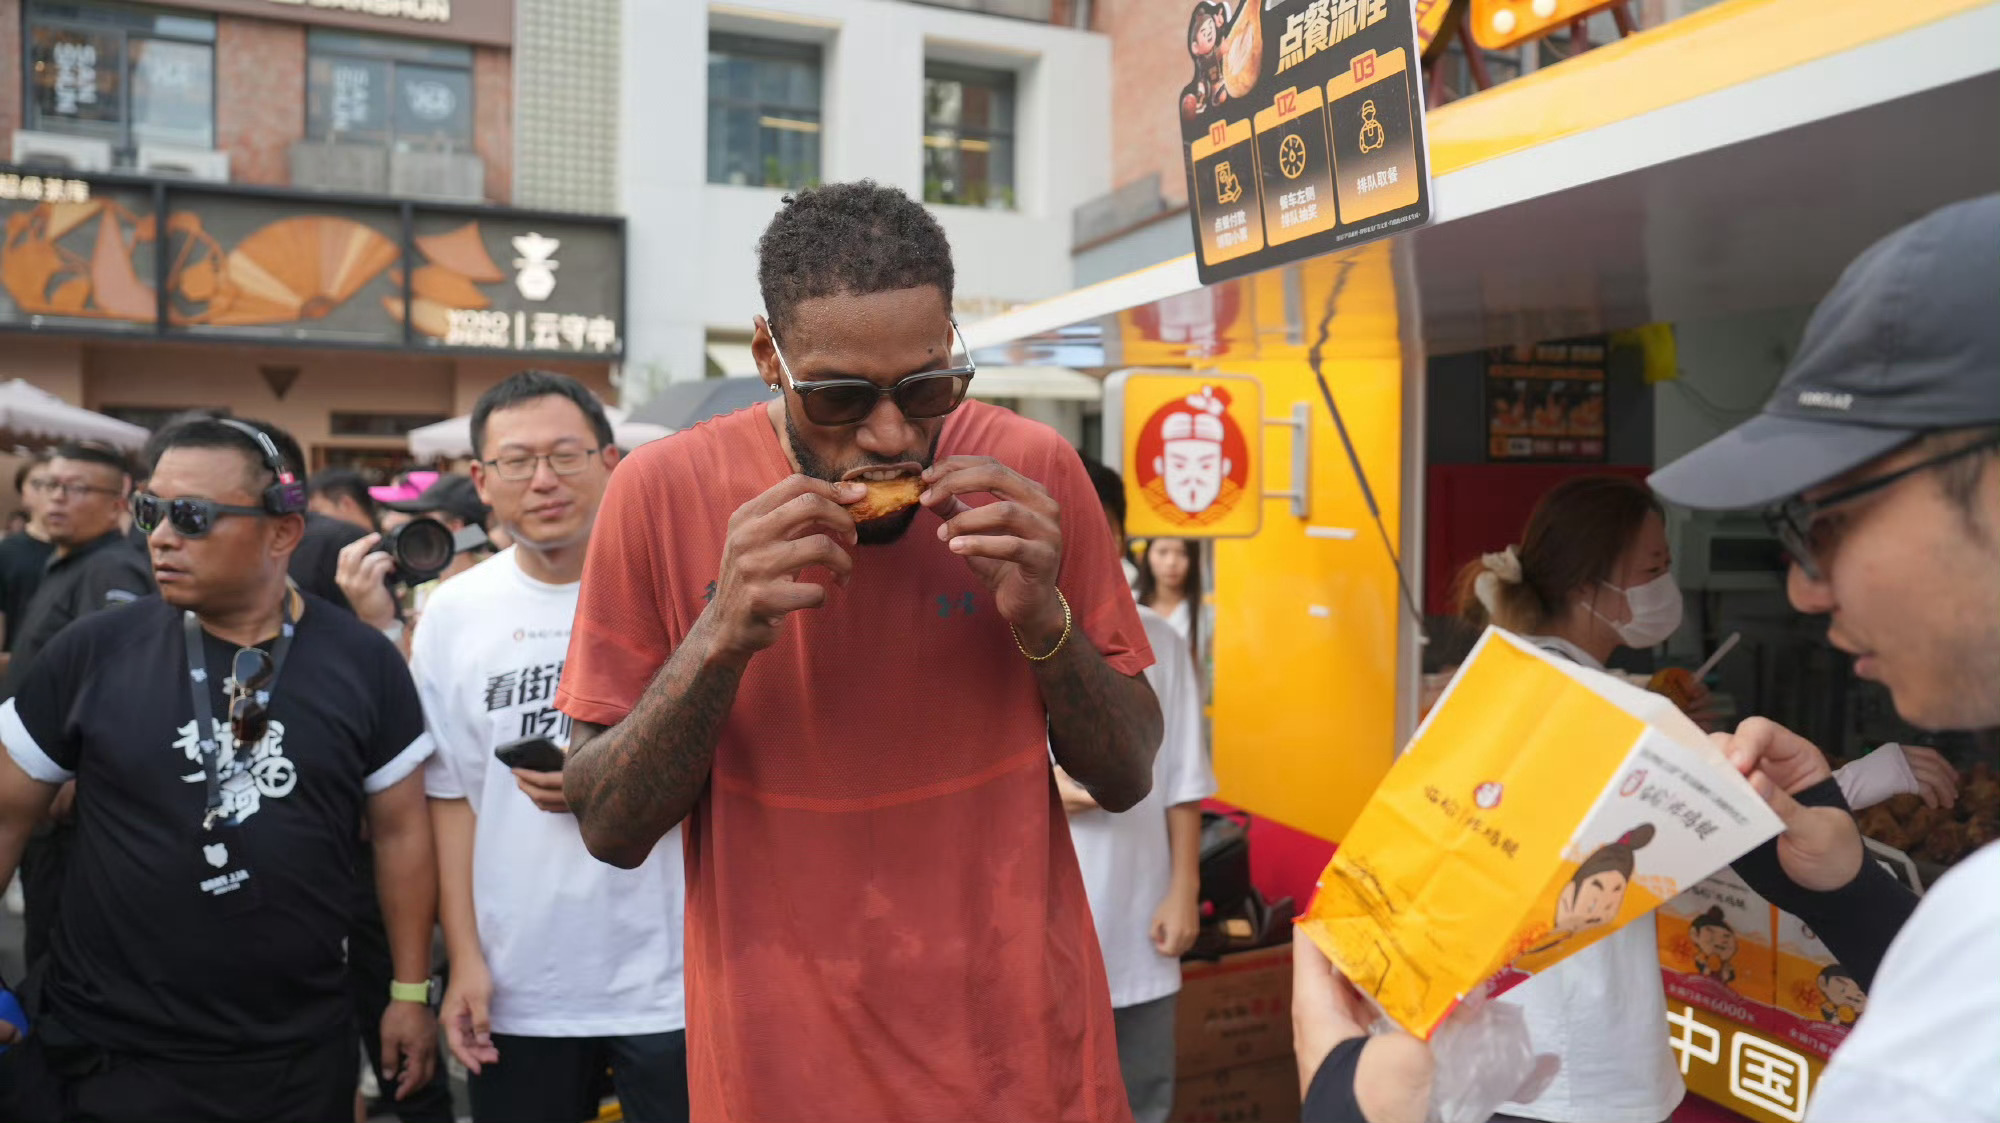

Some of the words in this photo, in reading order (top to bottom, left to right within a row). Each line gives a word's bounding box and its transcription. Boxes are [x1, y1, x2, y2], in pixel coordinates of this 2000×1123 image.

[1353, 54, 1375, 83] 03
[1276, 91, 1297, 117] 02
[1211, 126, 1225, 147] 01
[1357, 166, 1398, 195] 排队取餐
[1279, 185, 1315, 210] 餐车左侧
[485, 660, 565, 712] 看街
[521, 706, 572, 741] 吃
[1666, 1005, 1809, 1123] 中国
